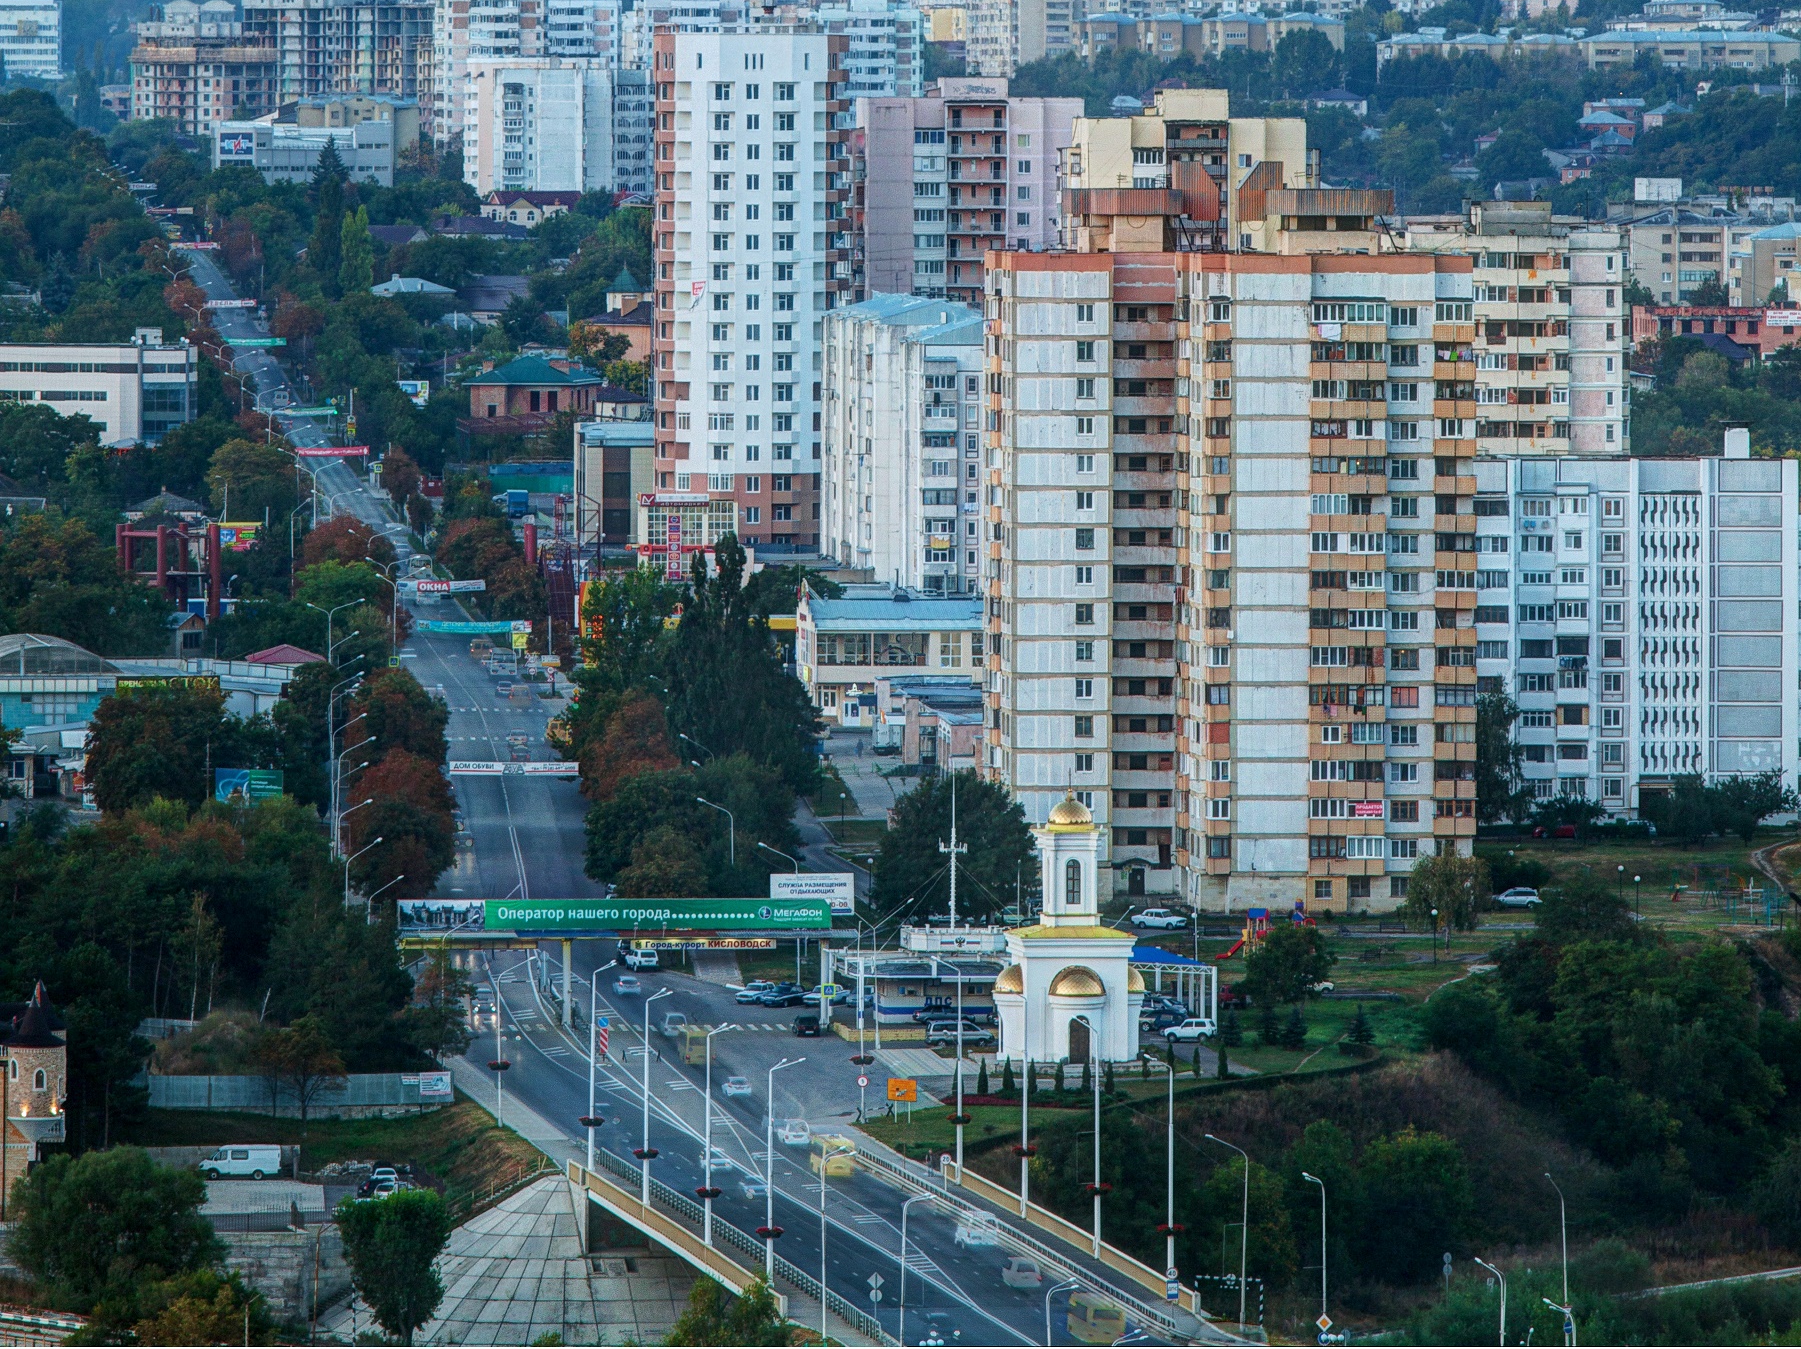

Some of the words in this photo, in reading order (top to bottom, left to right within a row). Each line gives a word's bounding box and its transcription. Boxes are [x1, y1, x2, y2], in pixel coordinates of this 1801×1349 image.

[419, 582, 449, 591] ОКНА
[498, 907, 565, 921] Оператор
[568, 908, 619, 919] нашего
[645, 940, 705, 950] Город-курорт
[708, 940, 771, 948] КИСЛОВОДСК
[924, 996, 952, 1007] ДПС
